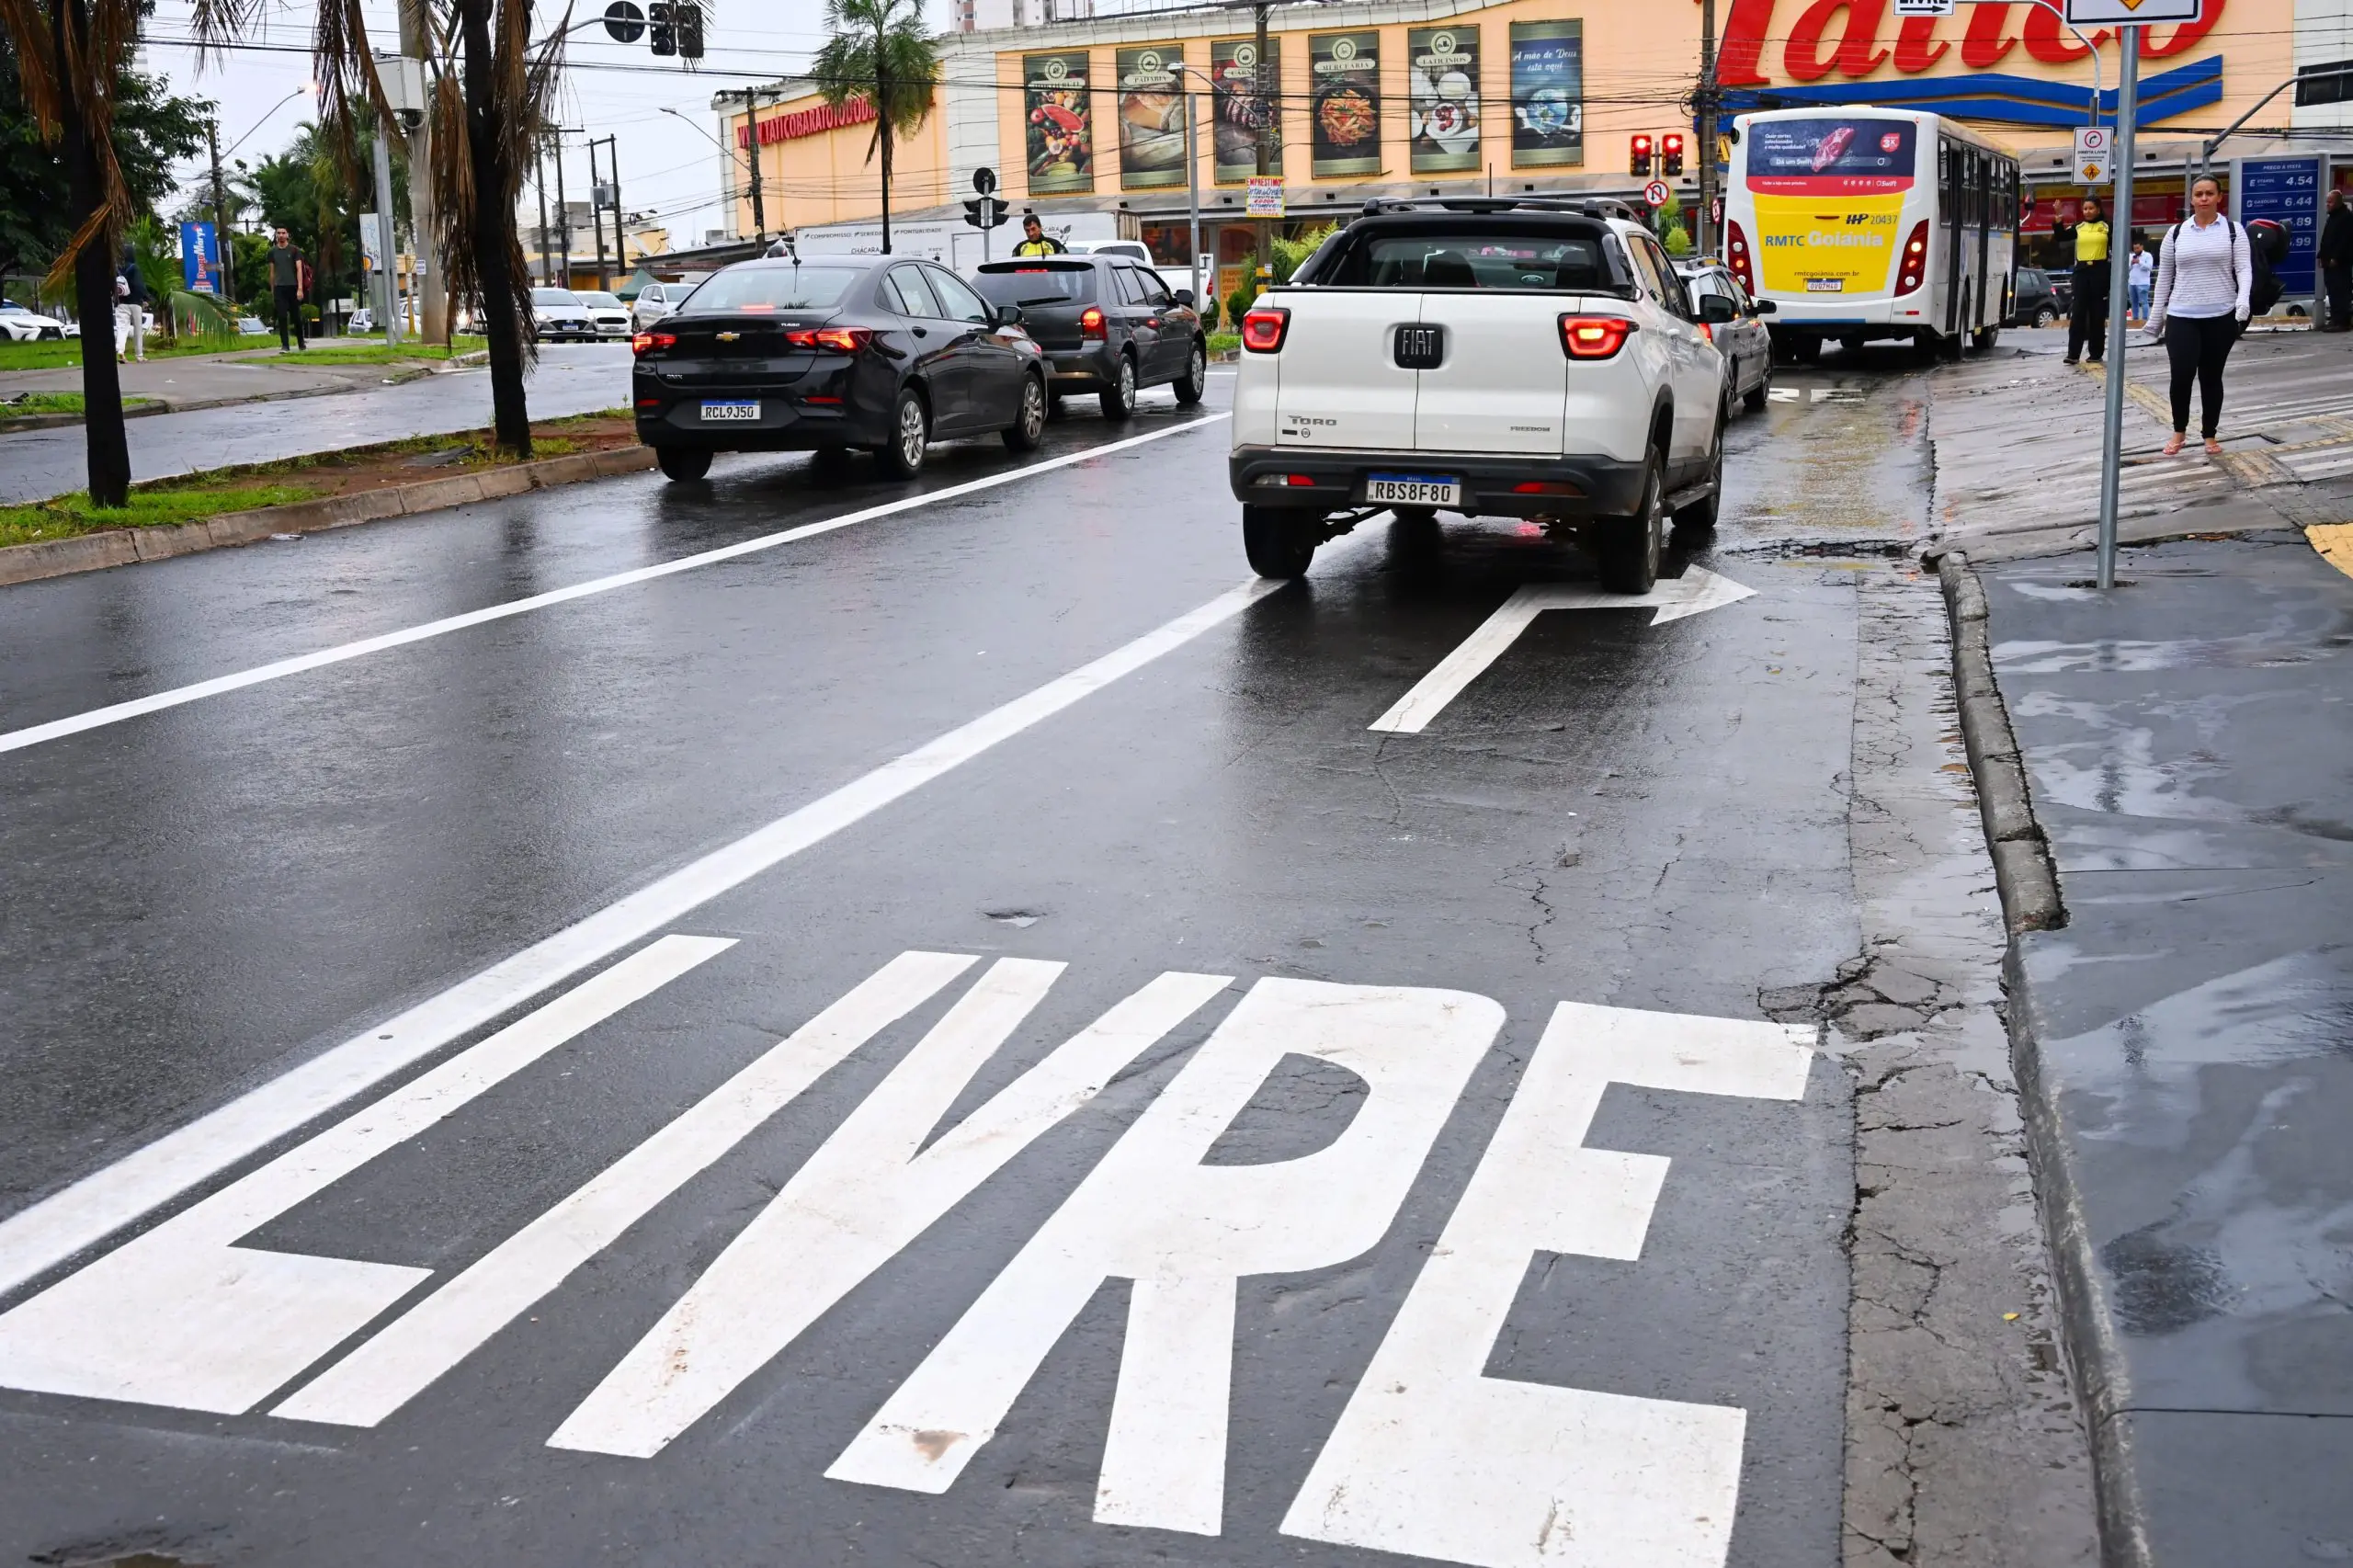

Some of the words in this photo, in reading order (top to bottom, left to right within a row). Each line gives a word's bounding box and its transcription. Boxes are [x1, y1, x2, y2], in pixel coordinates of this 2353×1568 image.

[1513, 51, 1522, 62] A
[1524, 51, 1541, 61] mão
[1543, 50, 1553, 59] de
[1555, 48, 1577, 59] Deus
[1134, 75, 1167, 84] PADARIA
[1870, 214, 1898, 225] 20437
[1765, 235, 1805, 246] RMTC
[1402, 329, 1435, 356] FIAT
[705, 406, 754, 418] RCL9J50
[1287, 415, 1337, 426] TORO
[1375, 482, 1451, 502] RBS8F80
[0, 934, 1819, 1568] LIVRE
